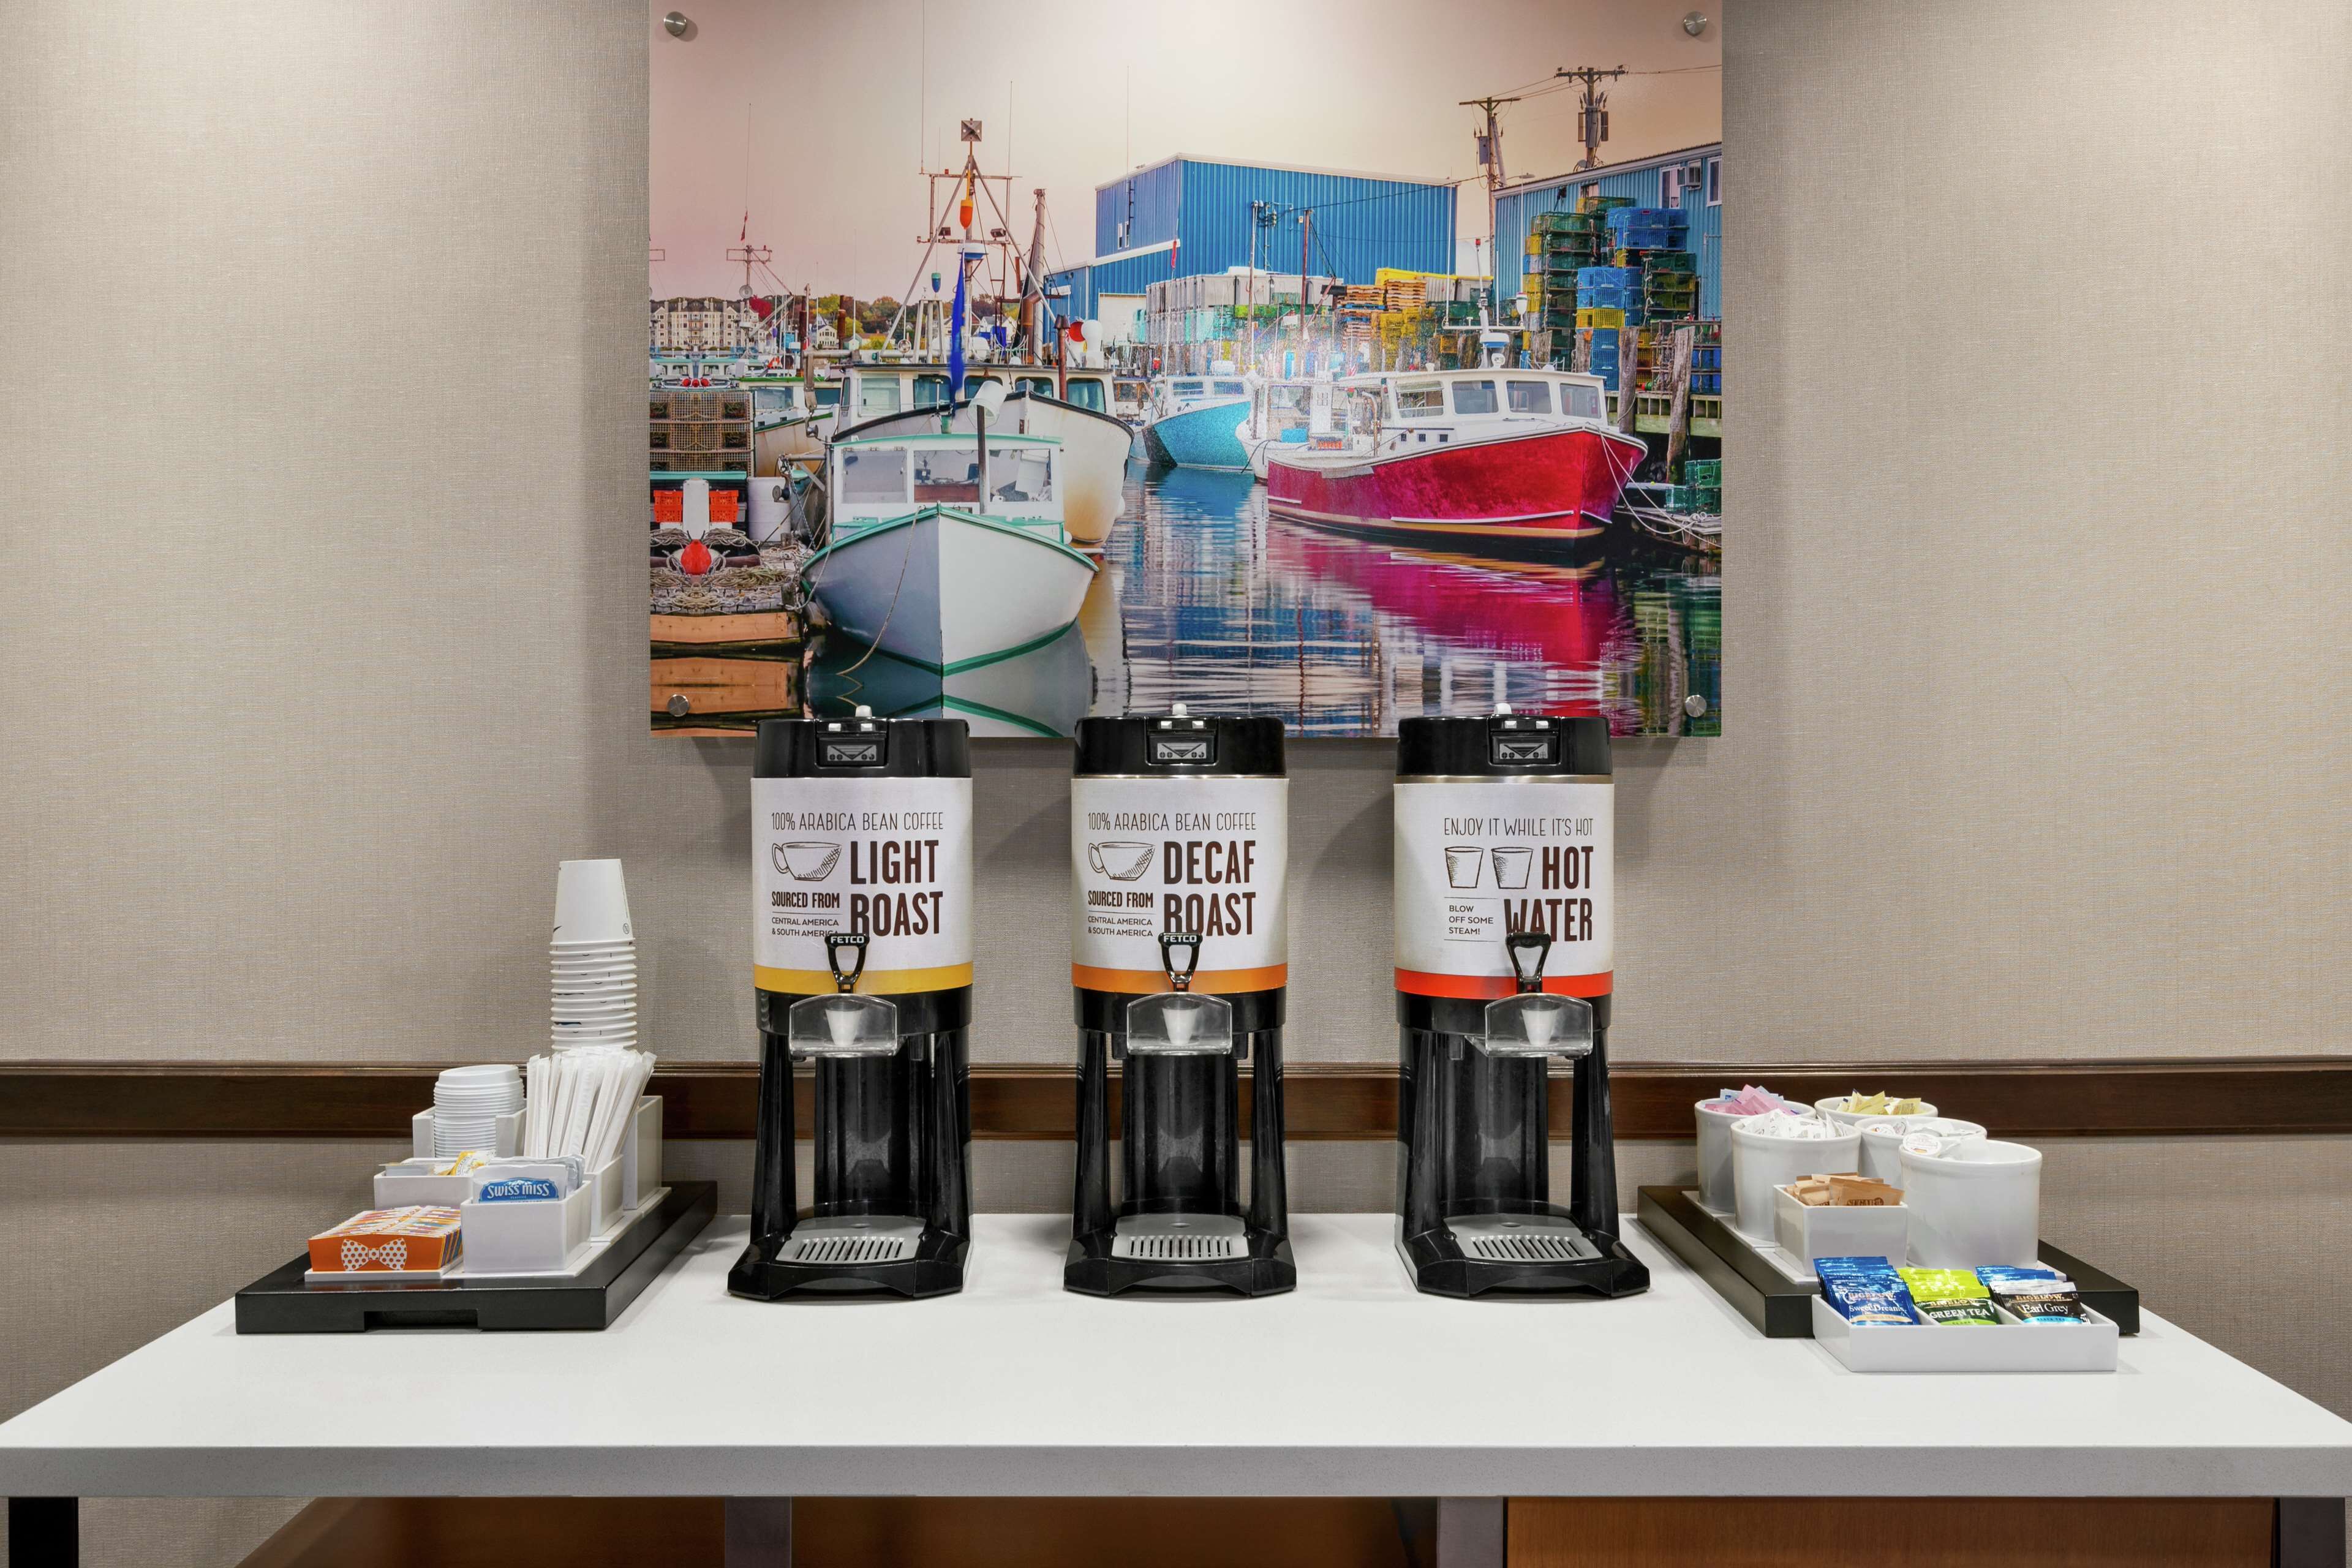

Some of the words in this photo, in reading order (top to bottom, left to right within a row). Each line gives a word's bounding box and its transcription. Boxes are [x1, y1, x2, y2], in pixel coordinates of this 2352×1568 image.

[772, 812, 795, 831] 100%
[799, 812, 856, 831] ARABICA
[862, 812, 897, 831] BEAN
[904, 812, 943, 830] COFFEE
[1088, 813, 1110, 831] 100%
[1114, 813, 1169, 831] ARABICA
[1176, 813, 1210, 831] BEAN
[1216, 812, 1256, 831] COFFEE
[1444, 818, 1483, 836] ENJOY
[1489, 818, 1500, 836] IT
[1504, 818, 1546, 836] WHILE
[1552, 818, 1572, 836] IT'S
[1576, 818, 1593, 836] HOT
[850, 840, 939, 884] LIGHT
[1164, 840, 1256, 884] DECAF
[1542, 846, 1594, 889] HOT
[772, 892, 808, 908] SOURCED
[812, 892, 840, 908] FROM
[1088, 891, 1123, 908] SOURCED
[1126, 892, 1153, 908] FROM
[772, 917, 801, 925] CENTRAL
[850, 891, 943, 937] ROAST
[1088, 916, 1116, 925] CENTRAL
[1164, 892, 1256, 937] ROAST
[1504, 898, 1593, 942] WATER
[1093, 927, 1115, 936] SOUTH
[1929, 1309, 1967, 1319] GREEN
[1967, 1308, 1991, 1316] TEA
[2022, 1303, 2044, 1313] Earl
[2045, 1303, 2068, 1314] Grey
